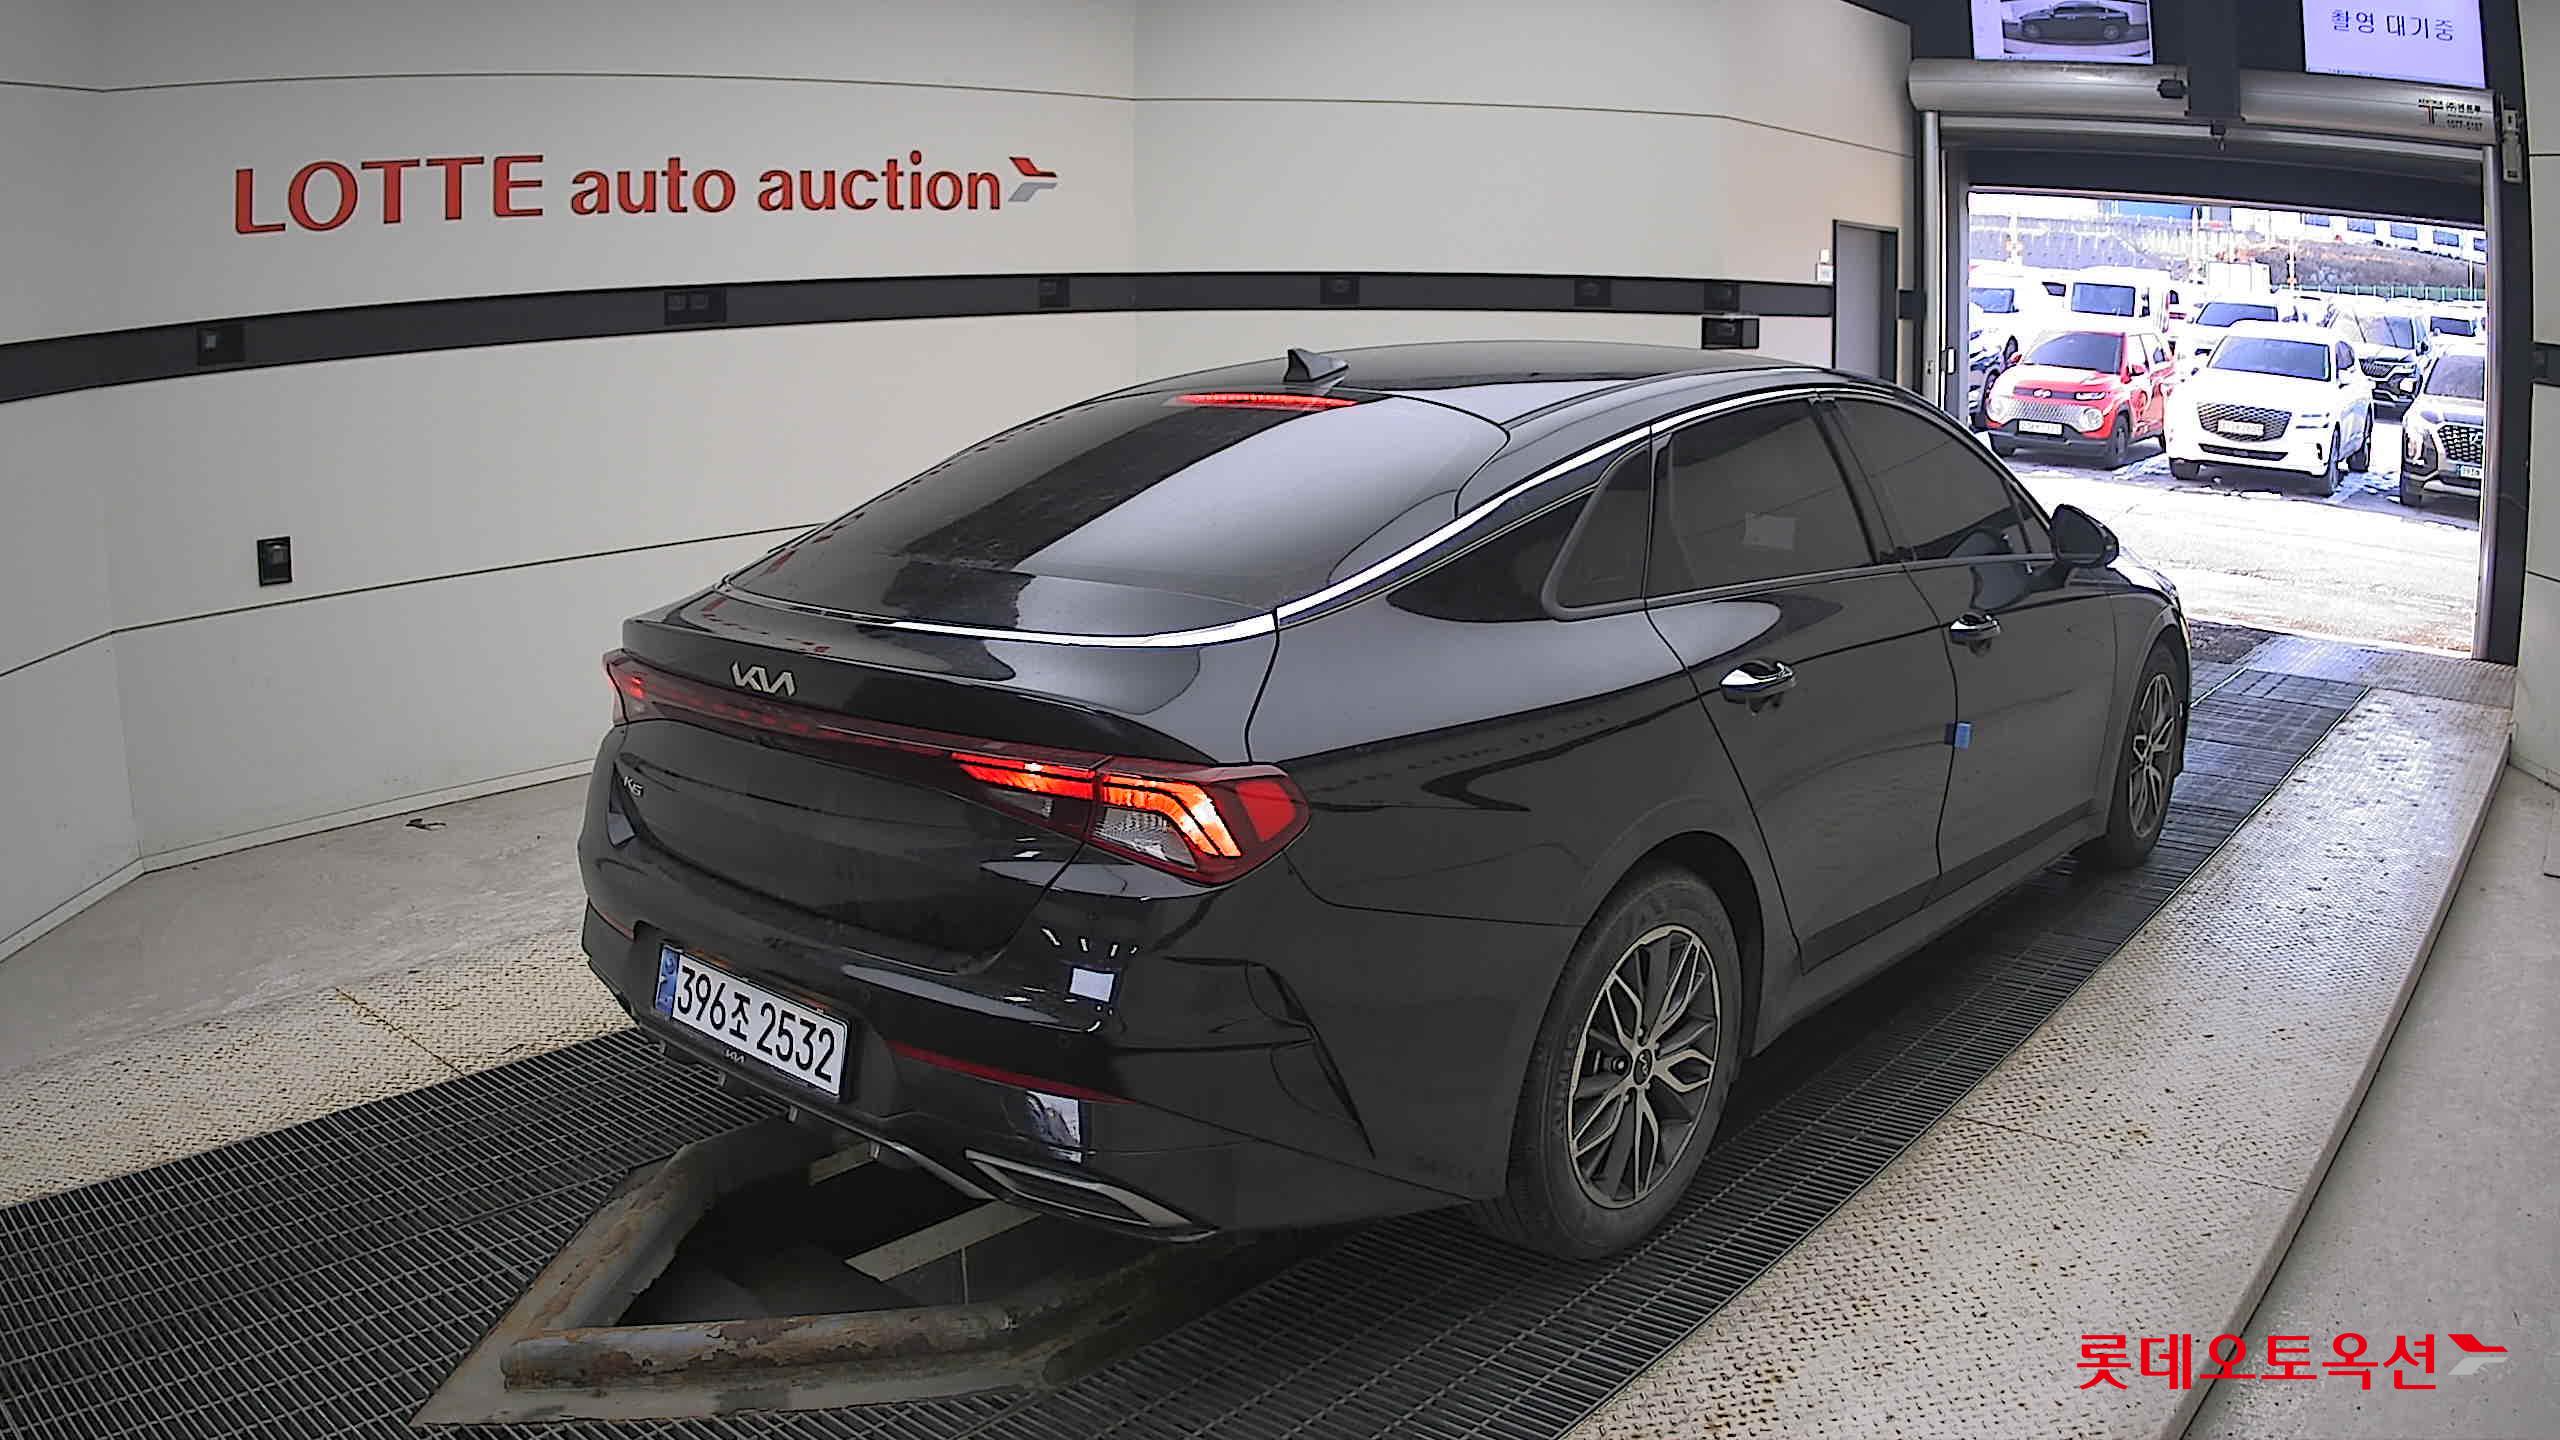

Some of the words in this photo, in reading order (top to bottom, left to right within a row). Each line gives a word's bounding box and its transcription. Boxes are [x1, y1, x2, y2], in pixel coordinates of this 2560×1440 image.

[2331, 9, 2375, 34] 촬영
[2386, 15, 2456, 43] 대기중
[235, 154, 544, 235] LOTTE
[569, 156, 737, 215] auto
[757, 149, 1003, 212] auction
[677, 965, 751, 1042] 396조
[756, 1002, 835, 1083] 2532
